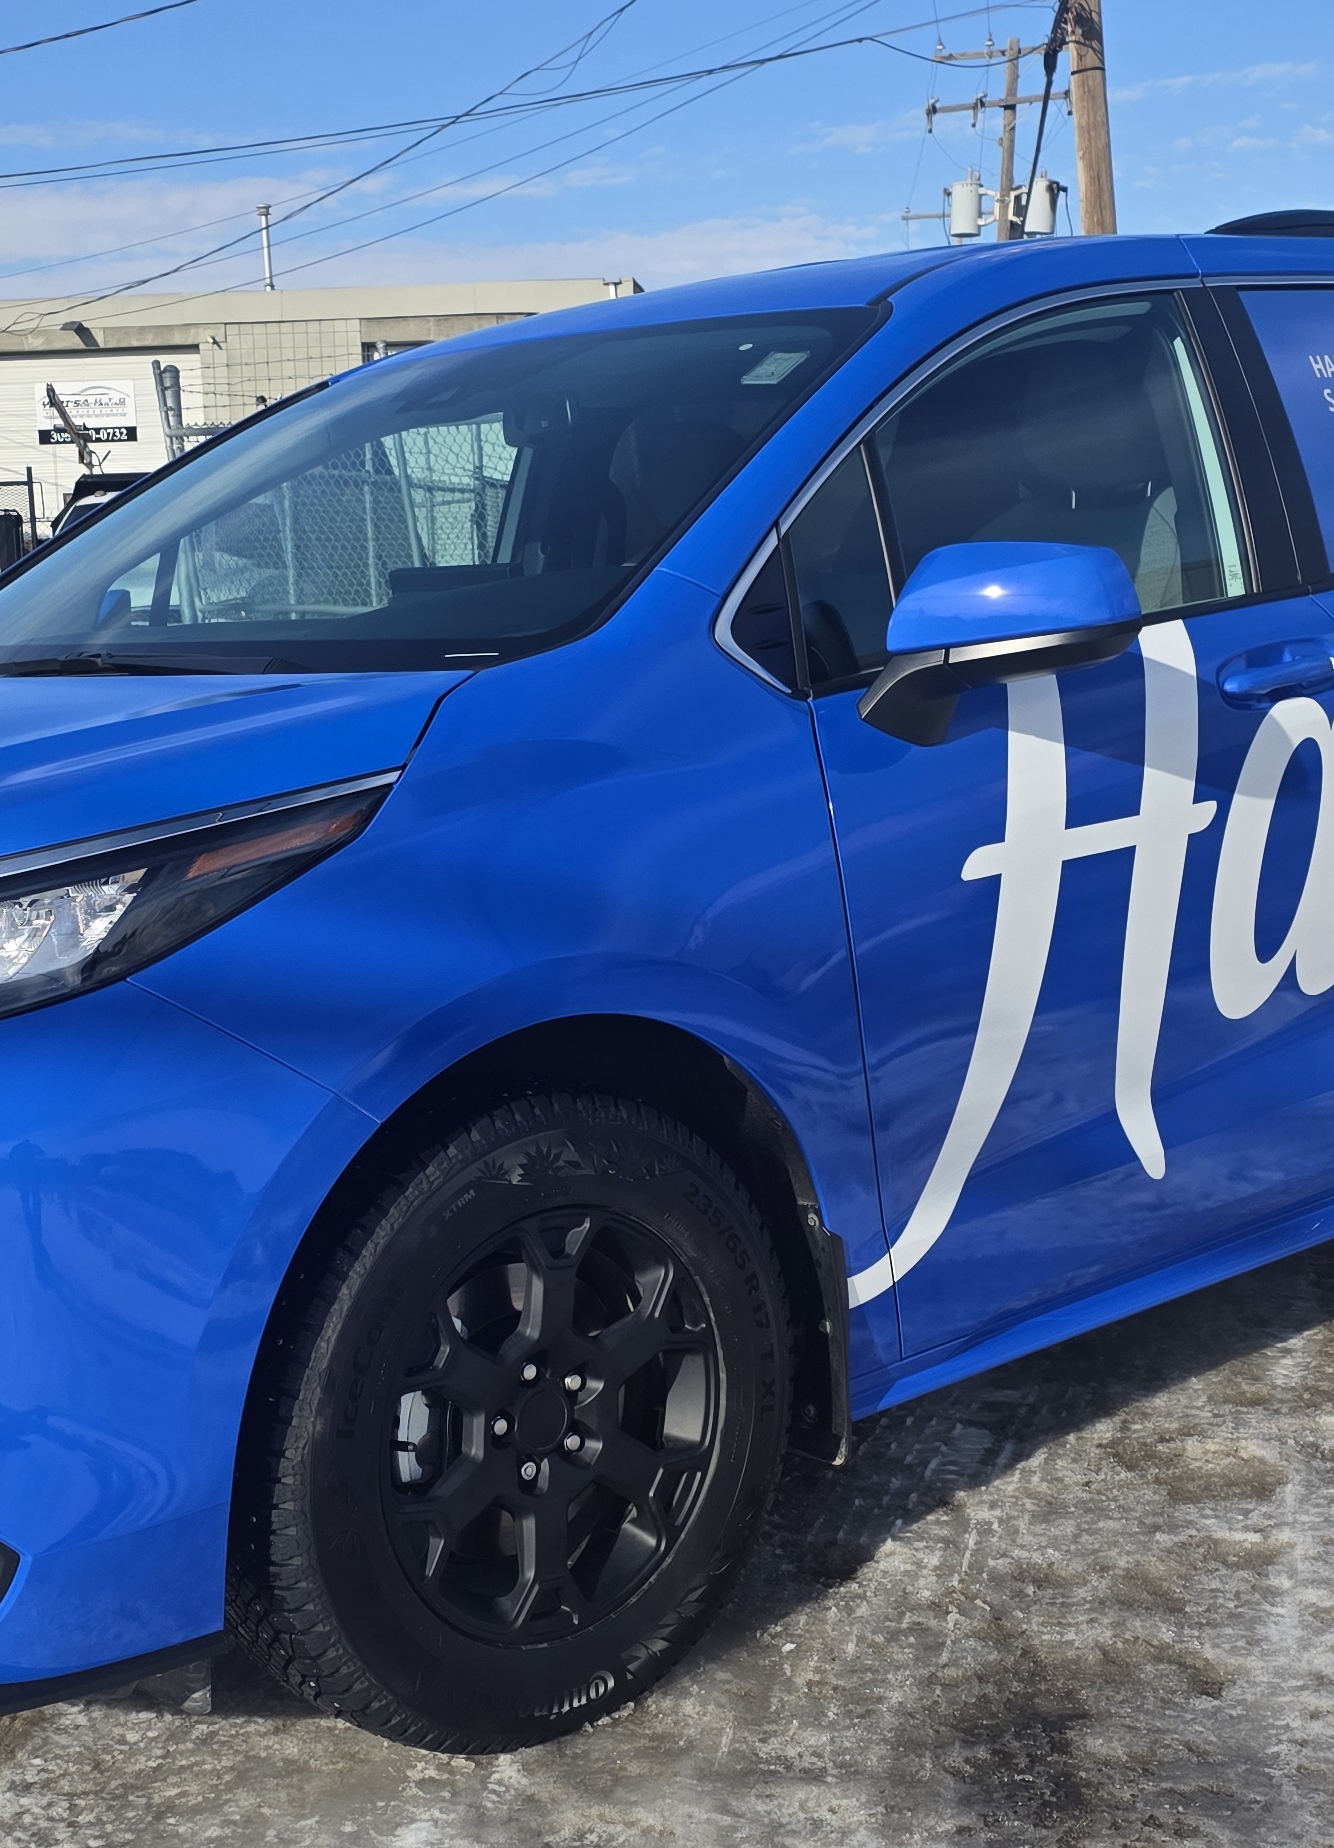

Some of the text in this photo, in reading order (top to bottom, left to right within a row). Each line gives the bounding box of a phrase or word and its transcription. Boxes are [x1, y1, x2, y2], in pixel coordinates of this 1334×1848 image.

[42, 399, 81, 409] YI'S
[442, 1188, 476, 1221] XTRM
[682, 1181, 752, 1273] 235/65
[337, 1262, 415, 1438] IceCont
